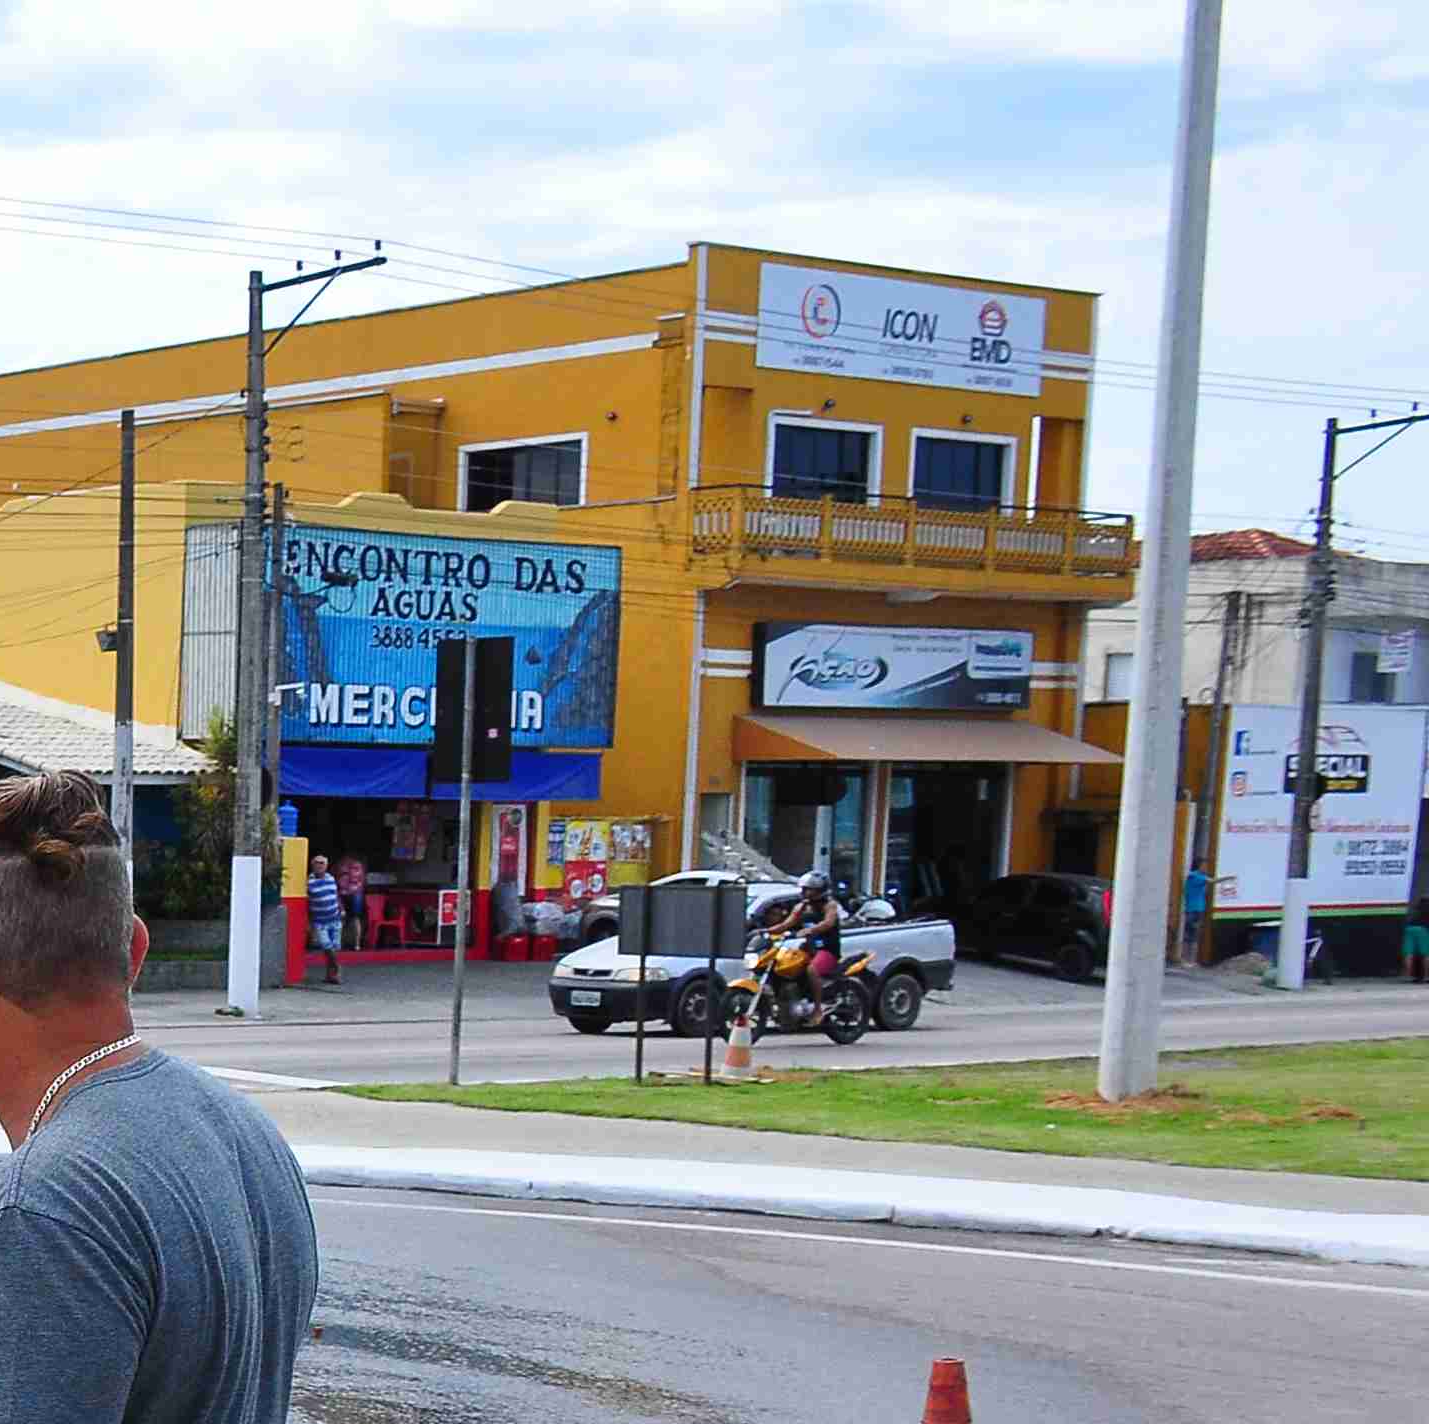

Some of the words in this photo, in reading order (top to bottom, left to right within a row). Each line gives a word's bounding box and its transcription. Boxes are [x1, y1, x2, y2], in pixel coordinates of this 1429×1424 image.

[882, 308, 939, 344] ICON
[969, 337, 1012, 364] EMD
[286, 538, 491, 590] ENCONTRO
[514, 556, 587, 594] DAS
